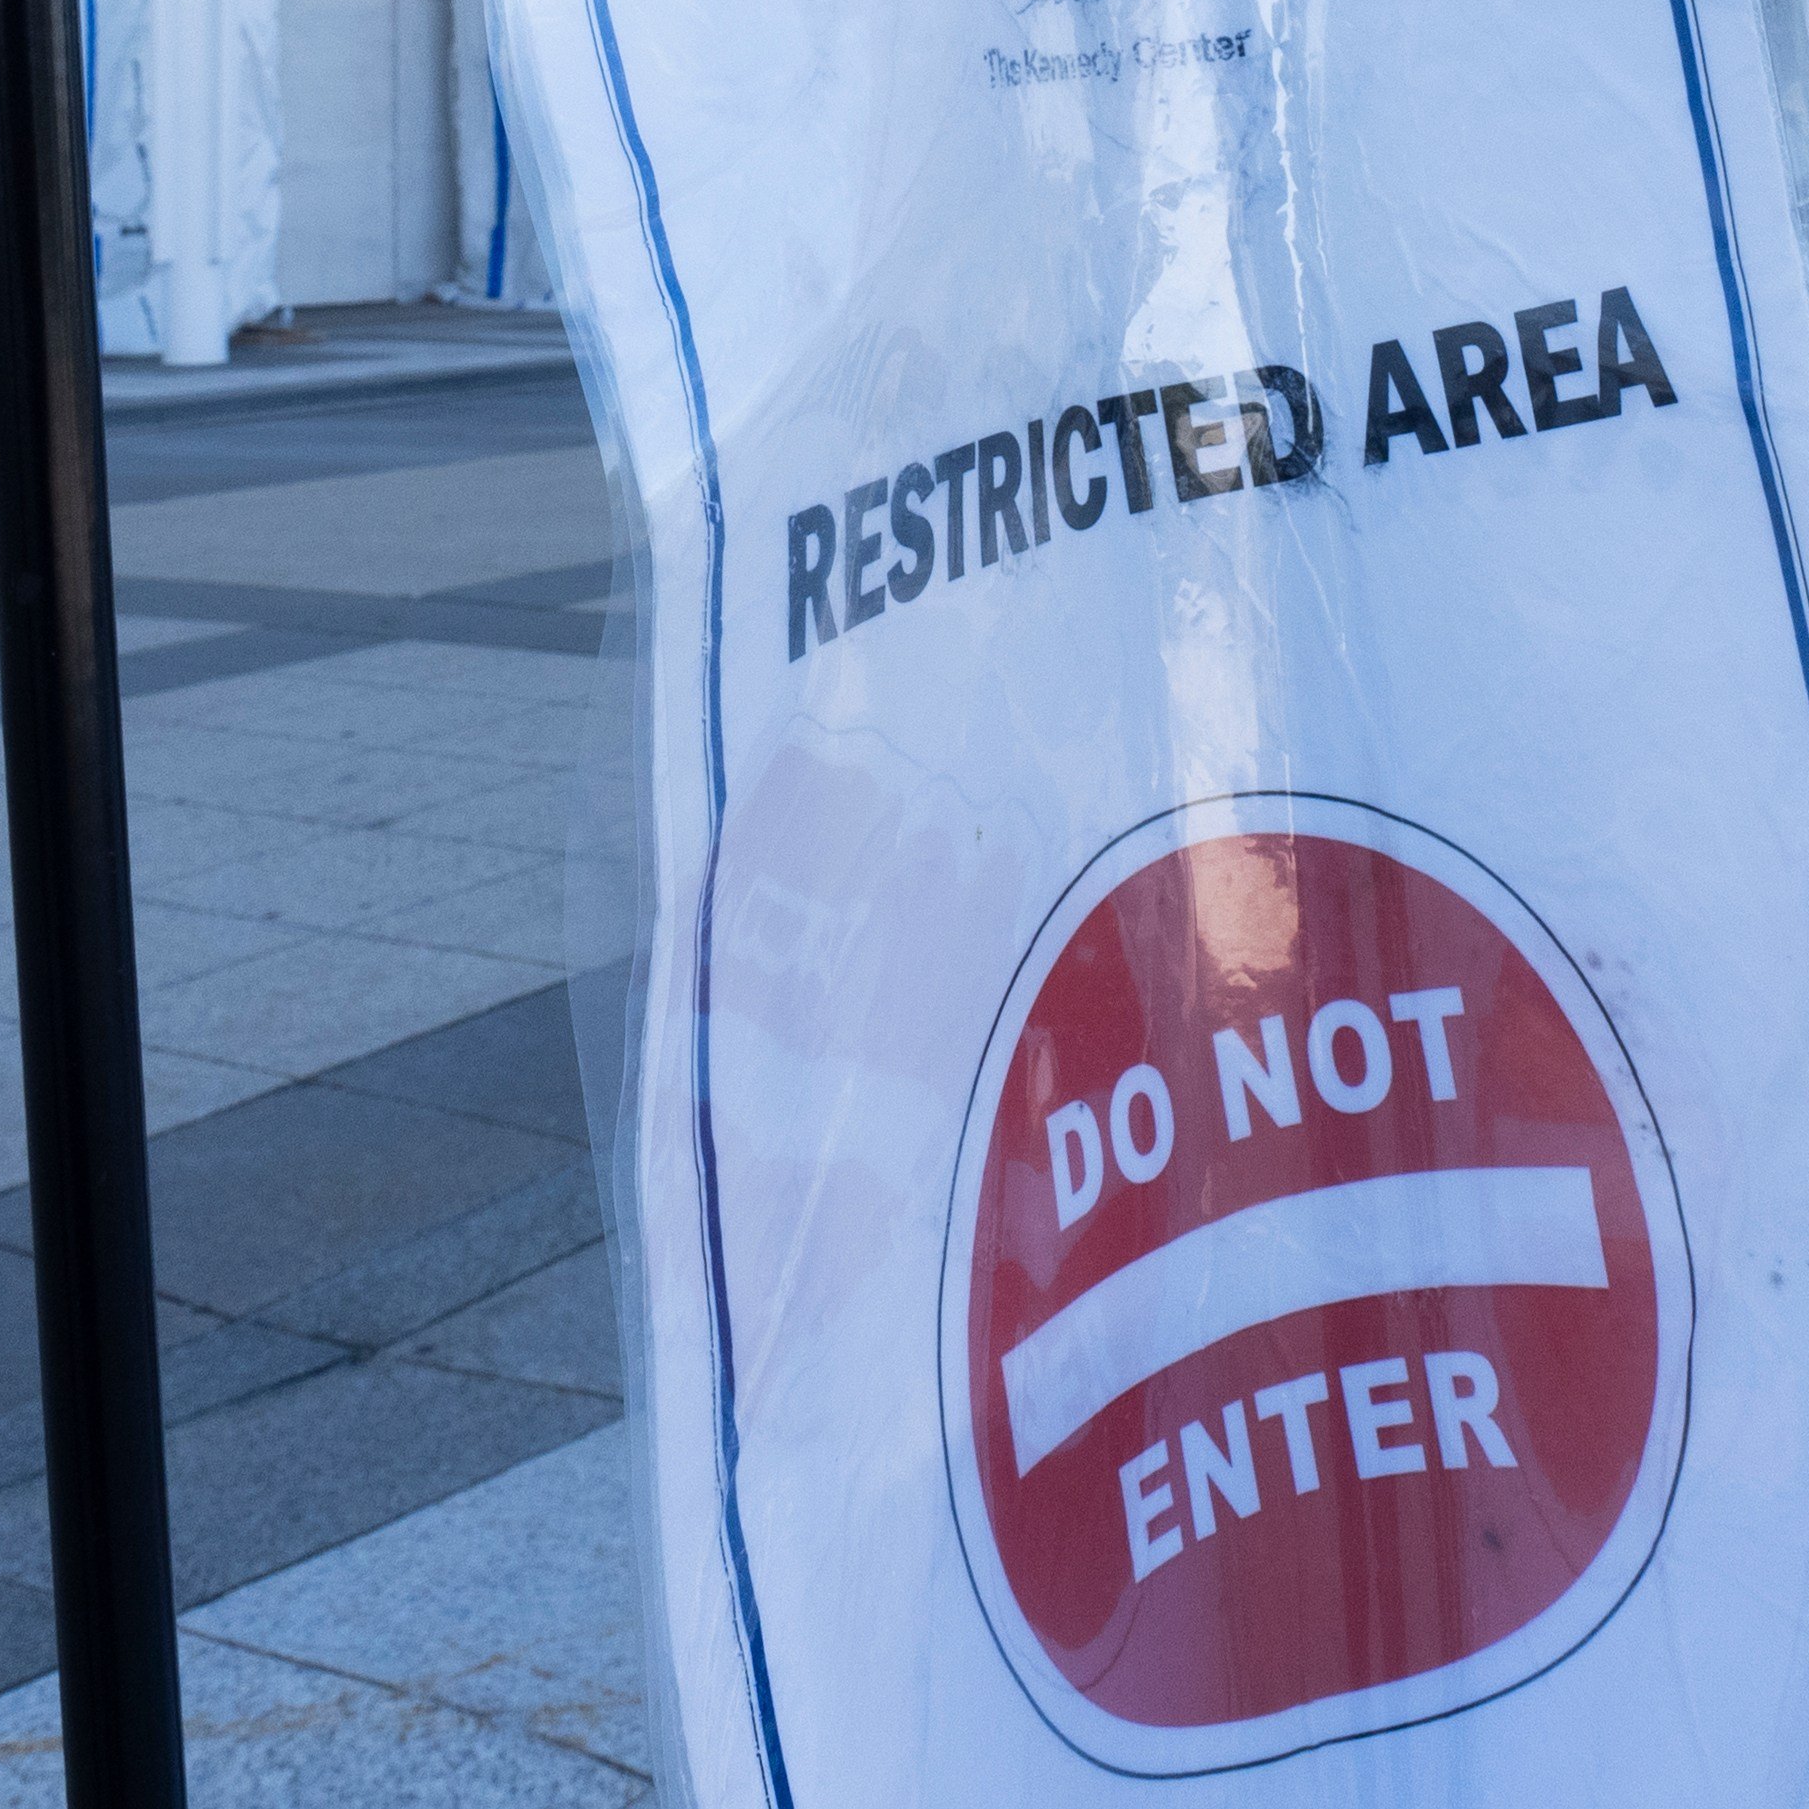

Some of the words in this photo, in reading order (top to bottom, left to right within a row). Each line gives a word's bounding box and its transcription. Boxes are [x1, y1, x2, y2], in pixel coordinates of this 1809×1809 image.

[983, 47, 1021, 88] The
[1132, 29, 1250, 68] Center
[788, 363, 1323, 663] RESTRICTED
[1362, 285, 1679, 467] AREA
[1046, 1062, 1176, 1232] DO
[1213, 986, 1465, 1142] NOT
[1117, 1349, 1518, 1584] ENTER
